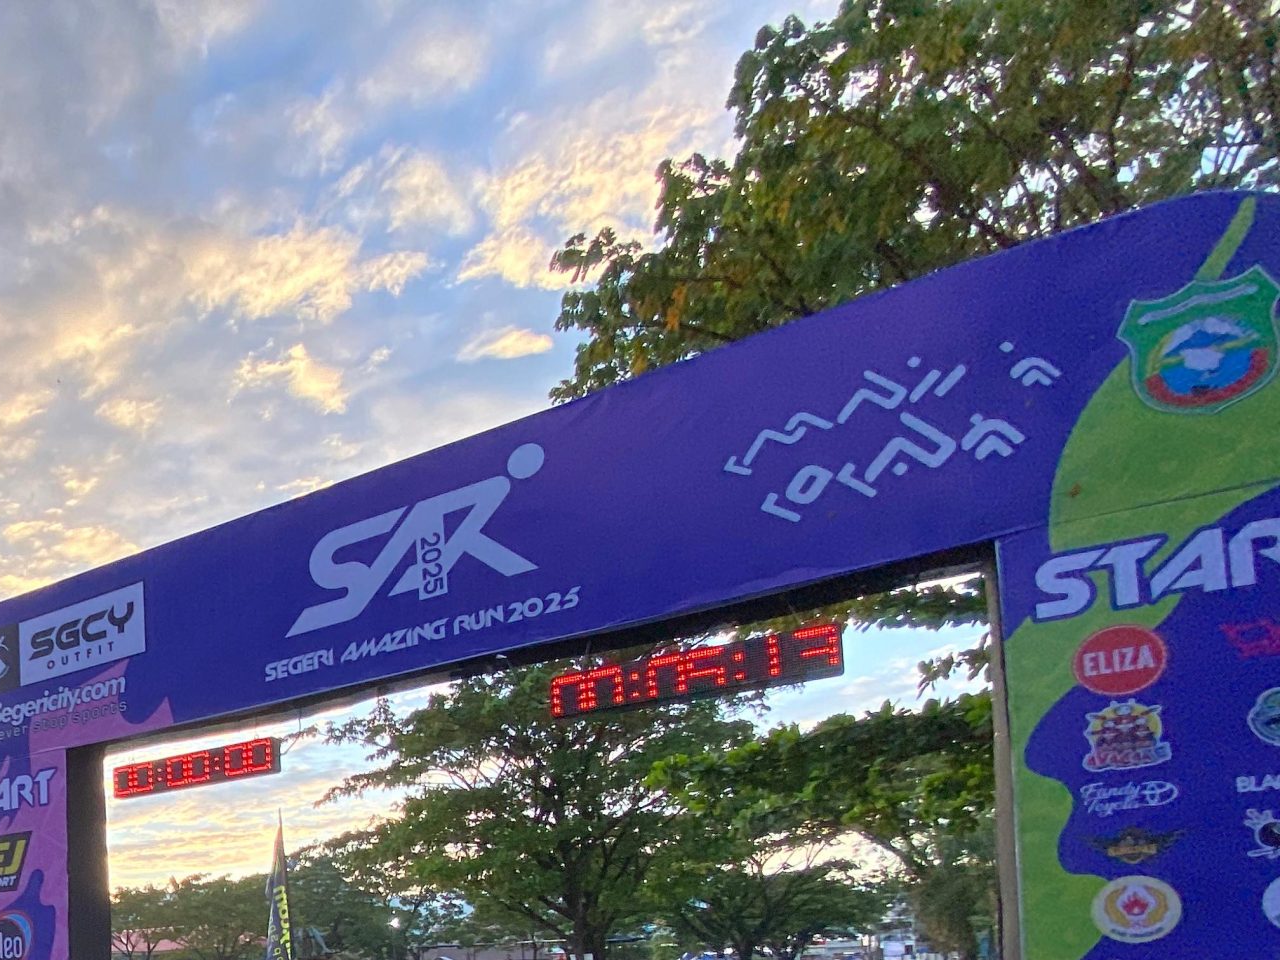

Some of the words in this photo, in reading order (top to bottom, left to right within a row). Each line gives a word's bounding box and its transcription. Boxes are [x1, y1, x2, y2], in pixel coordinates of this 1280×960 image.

[419, 532, 446, 596] 2025
[1034, 517, 1280, 619] STAR
[28, 602, 135, 662] SGCY
[46, 641, 116, 670] OUTFIT
[264, 647, 334, 682] SEGERI
[340, 617, 447, 664] AMAZING
[453, 603, 505, 637] RUN
[507, 586, 582, 624] 2025
[1082, 644, 1155, 677] ELIZA
[31, 711, 69, 735] stop
[73, 700, 128, 730] sports
[113, 738, 272, 798] 00:00:00
